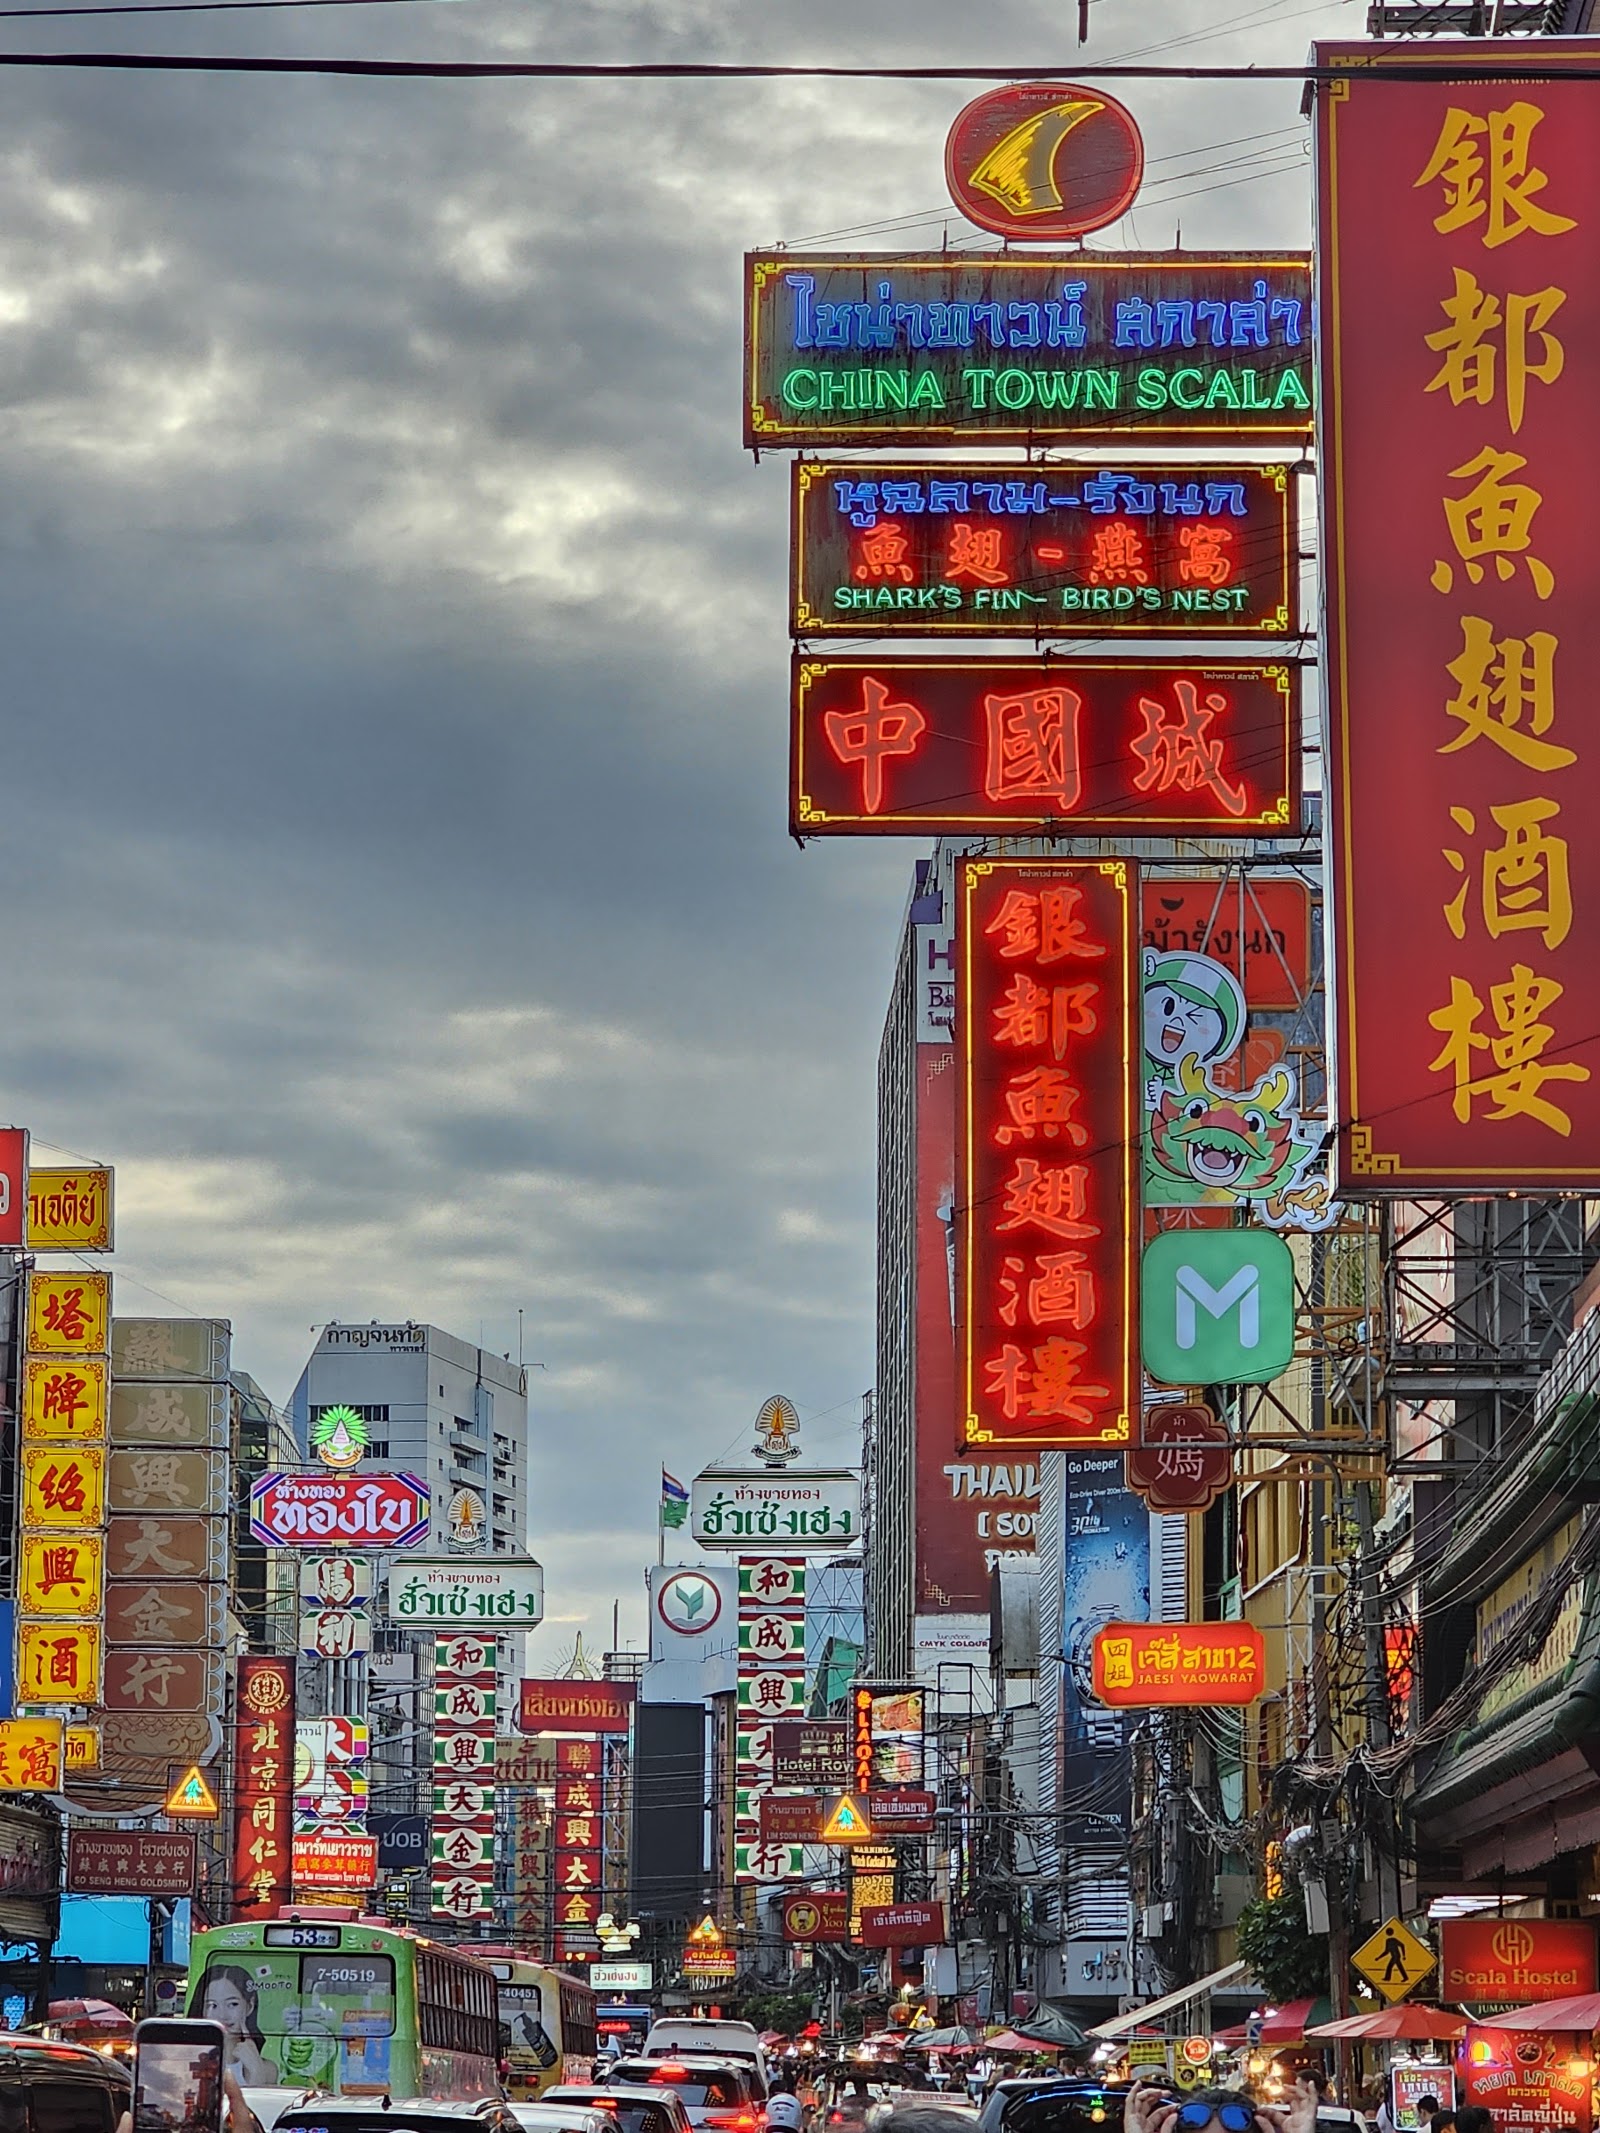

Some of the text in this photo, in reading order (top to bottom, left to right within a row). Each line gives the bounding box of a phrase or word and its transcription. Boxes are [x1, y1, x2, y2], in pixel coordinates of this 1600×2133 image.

[785, 273, 1304, 349] ไชน่าทาวน์ สกาล่า
[783, 368, 1310, 411] CHINA TOWN SCALA
[833, 584, 962, 610] SHARK'S
[1061, 585, 1162, 611] BIRD'S
[1172, 588, 1249, 611] NEST
[1413, 101, 1592, 1138] 銀都魚翅酒樓
[824, 676, 1247, 815] 中國城
[984, 886, 1109, 1424] 銀都魚翅酒樓
[1175, 1263, 1260, 1350] M
[1068, 1459, 1119, 1474] Go Deeper
[1155, 1431, 1205, 1481] 媽
[35, 1287, 94, 1690] 塔牌紹興酒
[275, 1481, 346, 1500] ห้างทอง
[734, 1484, 821, 1500] ห้างขายทอง
[271, 1484, 414, 1535] ทองใบ
[427, 1569, 501, 1584] ห้างขายทอง
[1107, 1642, 1131, 1682] 四姐
[1138, 1672, 1254, 1685] JAESI YAOWARAT
[752, 1564, 790, 1877] 和成興行
[445, 1640, 483, 1914] 和成興大金行
[777, 1757, 816, 1771] Hotel
[248, 1719, 282, 1904] 北京同仁堂
[383, 1832, 422, 1848] UOB
[74, 1876, 190, 1888] SO SENG HENG GOLDSMITH
[291, 1928, 318, 1946] 53
[246, 1979, 293, 1992] SMOOTO
[317, 1968, 376, 1982] 7-50519
[1450, 1968, 1507, 1985] Scala
[1513, 1968, 1578, 1985] Hostel
